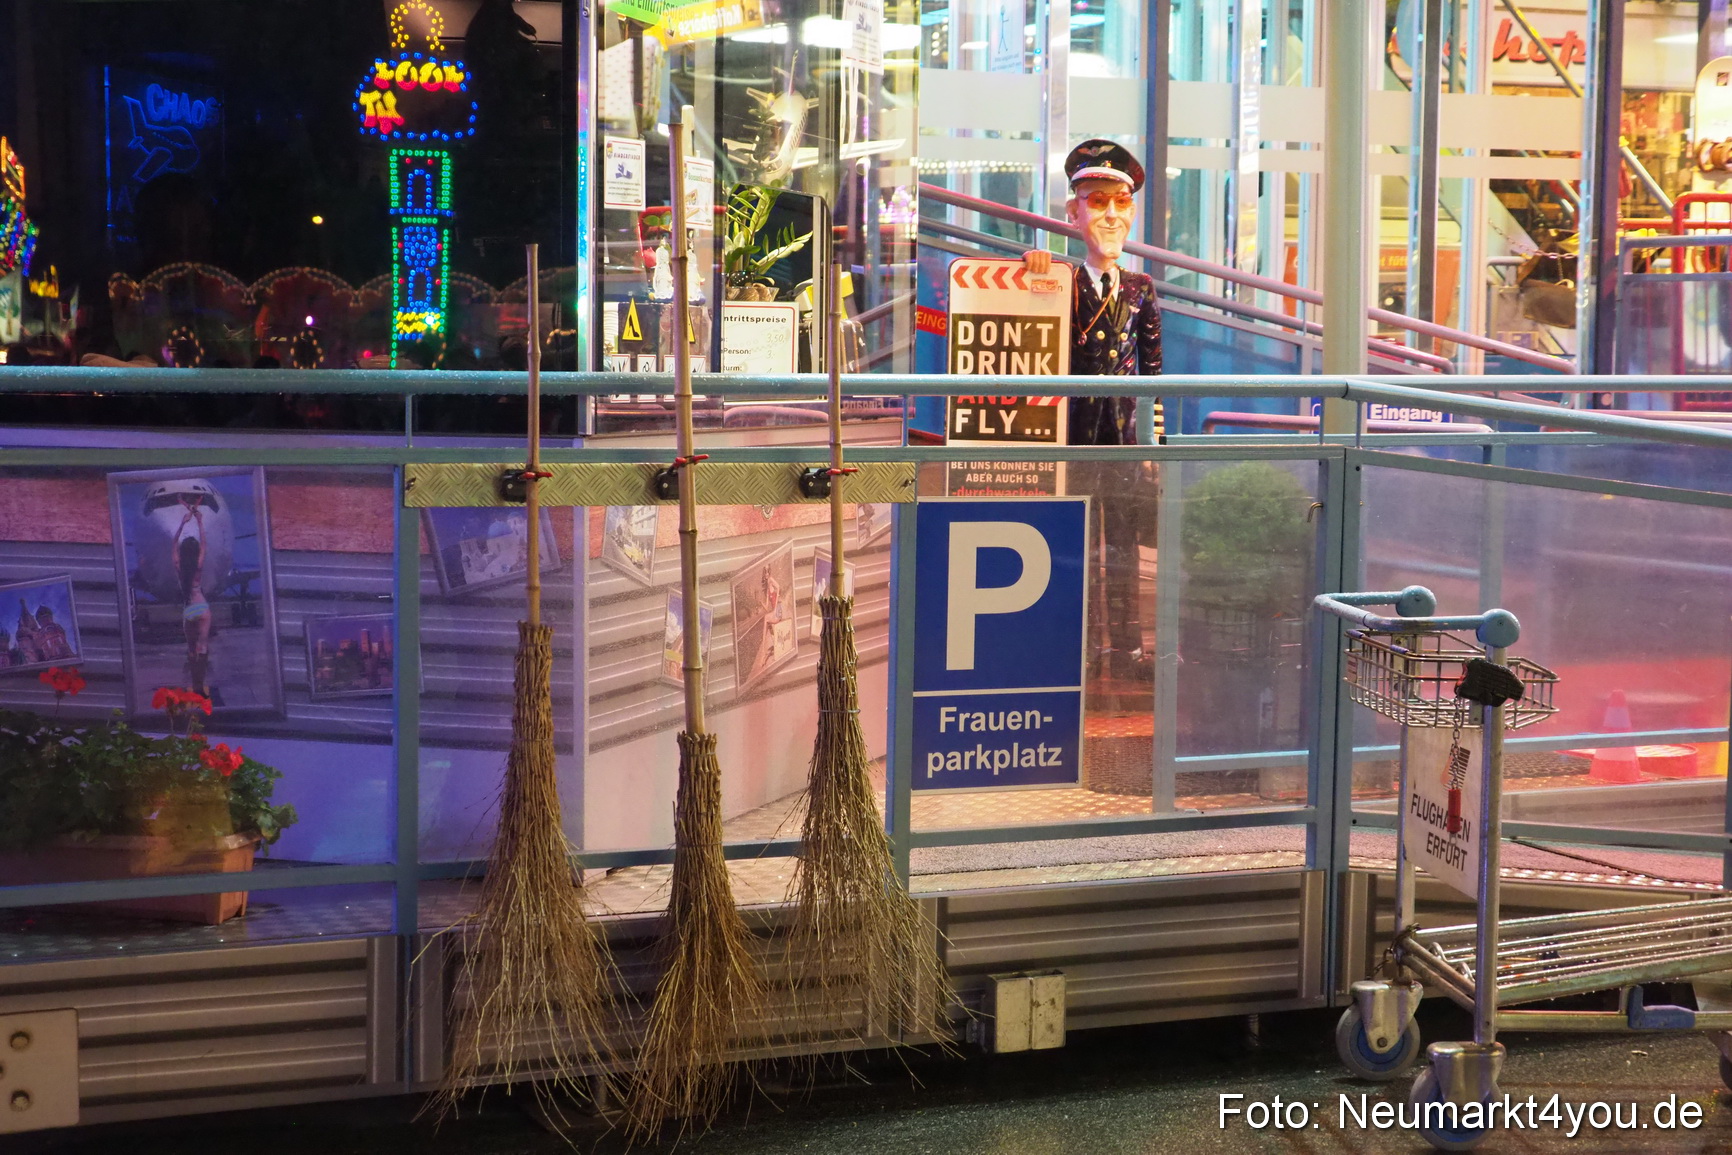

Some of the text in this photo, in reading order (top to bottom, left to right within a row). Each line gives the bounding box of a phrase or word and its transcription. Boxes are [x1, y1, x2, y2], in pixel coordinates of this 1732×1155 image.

[723, 315, 787, 324] ntrittspreise
[957, 350, 1053, 375] DRINK
[1371, 403, 1443, 423] Eingang
[951, 461, 967, 470] BEI
[970, 461, 991, 470] UNS
[1038, 462, 1055, 472] SIE
[966, 473, 1039, 484] ABER AUCH SO
[946, 521, 1052, 671] P
[940, 706, 1053, 733] Frauen-
[927, 742, 1062, 779] parkplatz
[1410, 793, 1471, 843] FLUGHAEN
[1426, 831, 1468, 872] ERFURT
